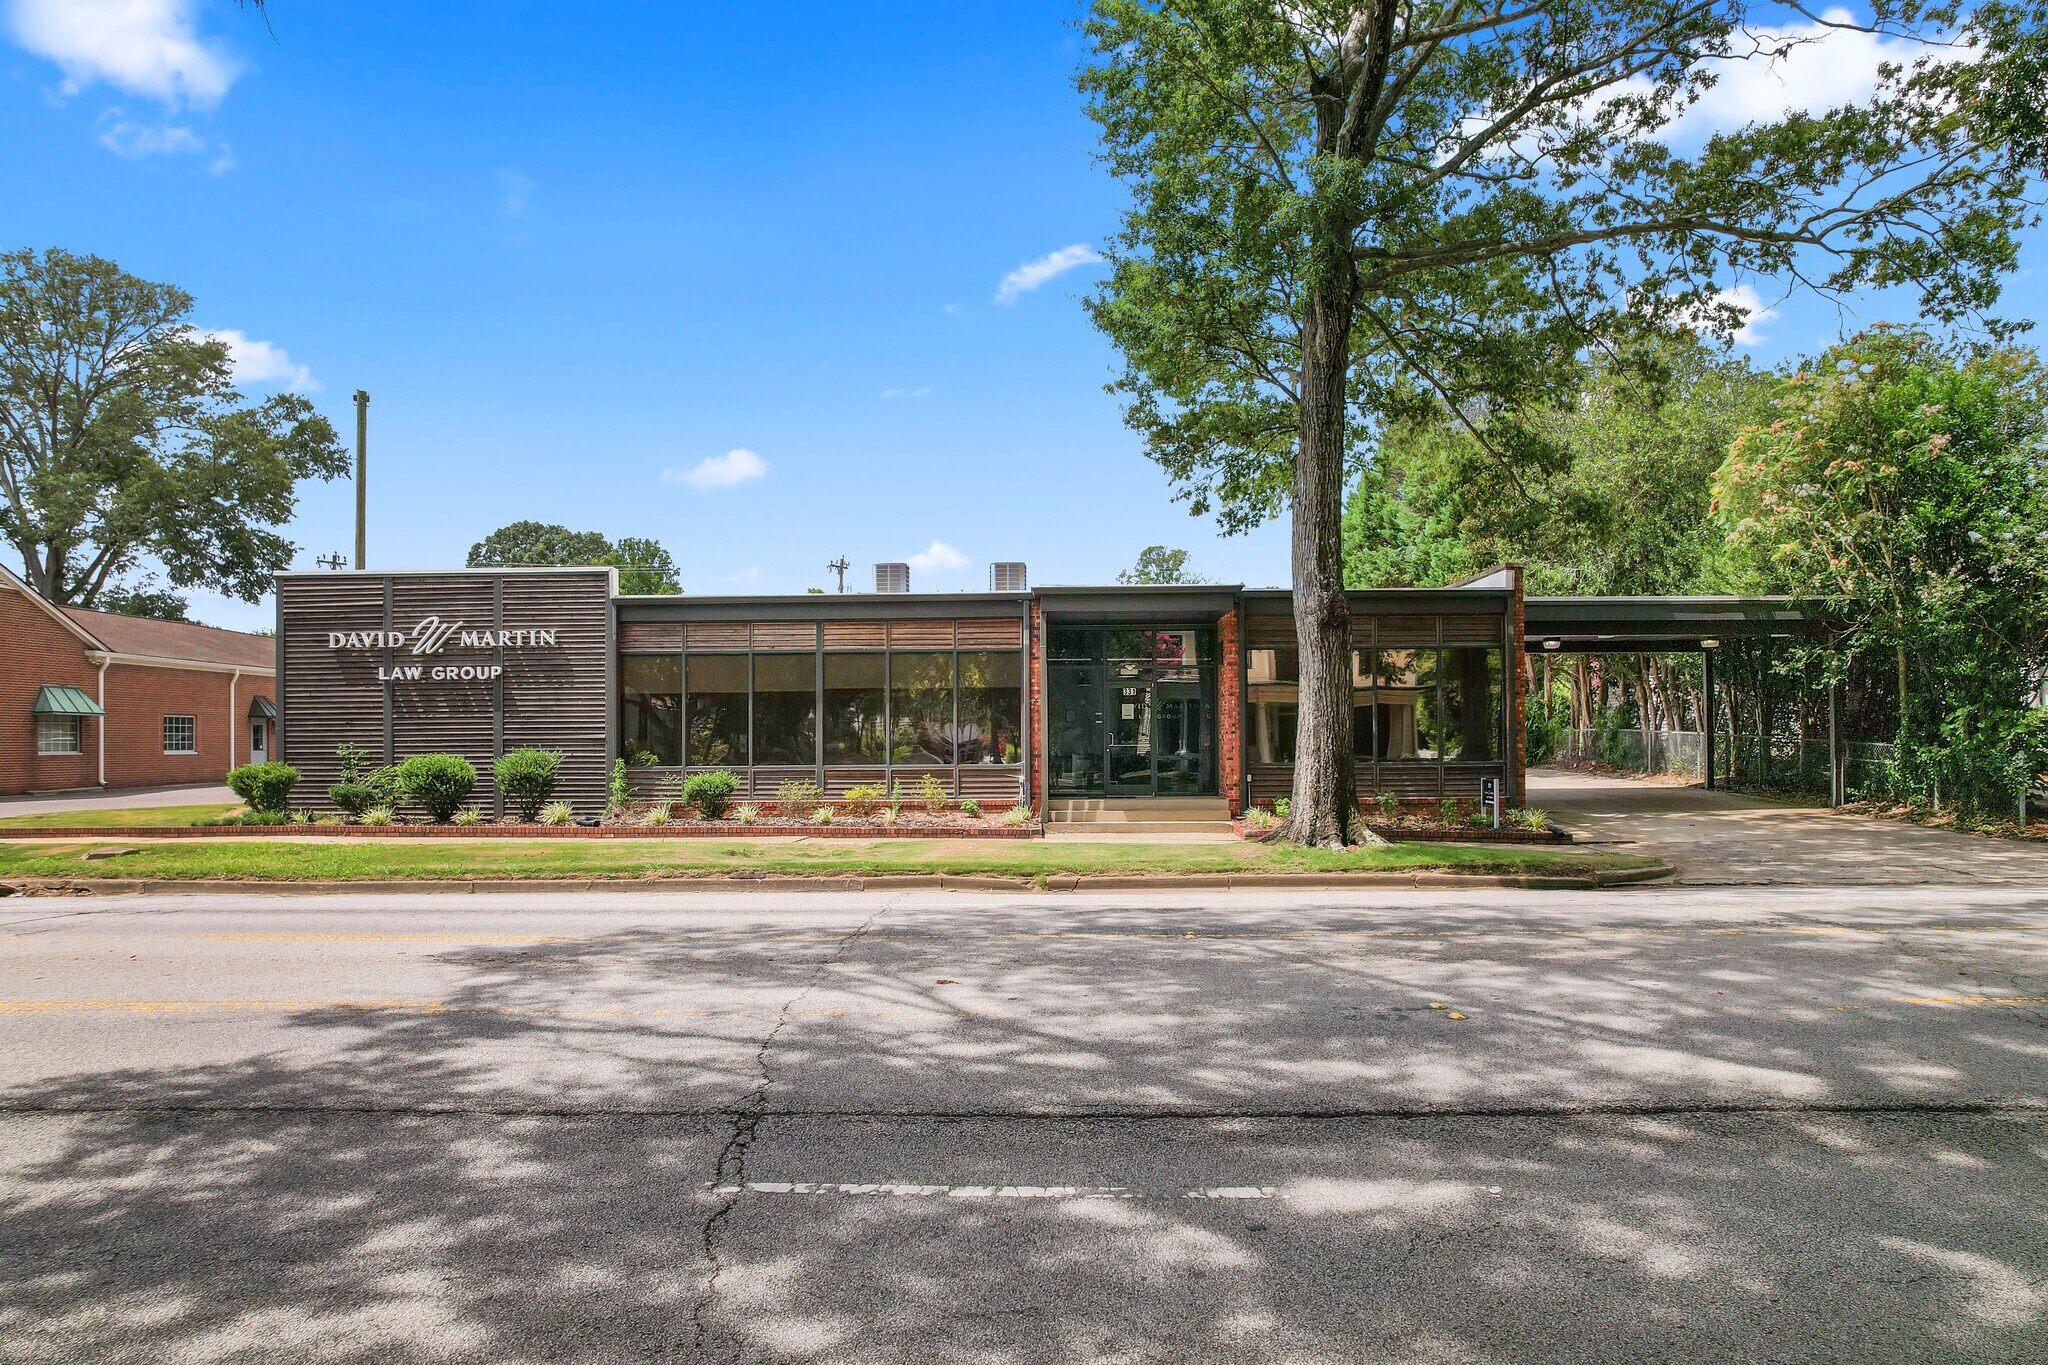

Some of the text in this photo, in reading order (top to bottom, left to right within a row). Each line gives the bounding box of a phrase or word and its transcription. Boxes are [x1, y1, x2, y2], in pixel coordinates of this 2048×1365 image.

[328, 631, 405, 648] DAVID
[460, 630, 557, 647] MARTIN
[378, 665, 502, 681] LAW GROUP
